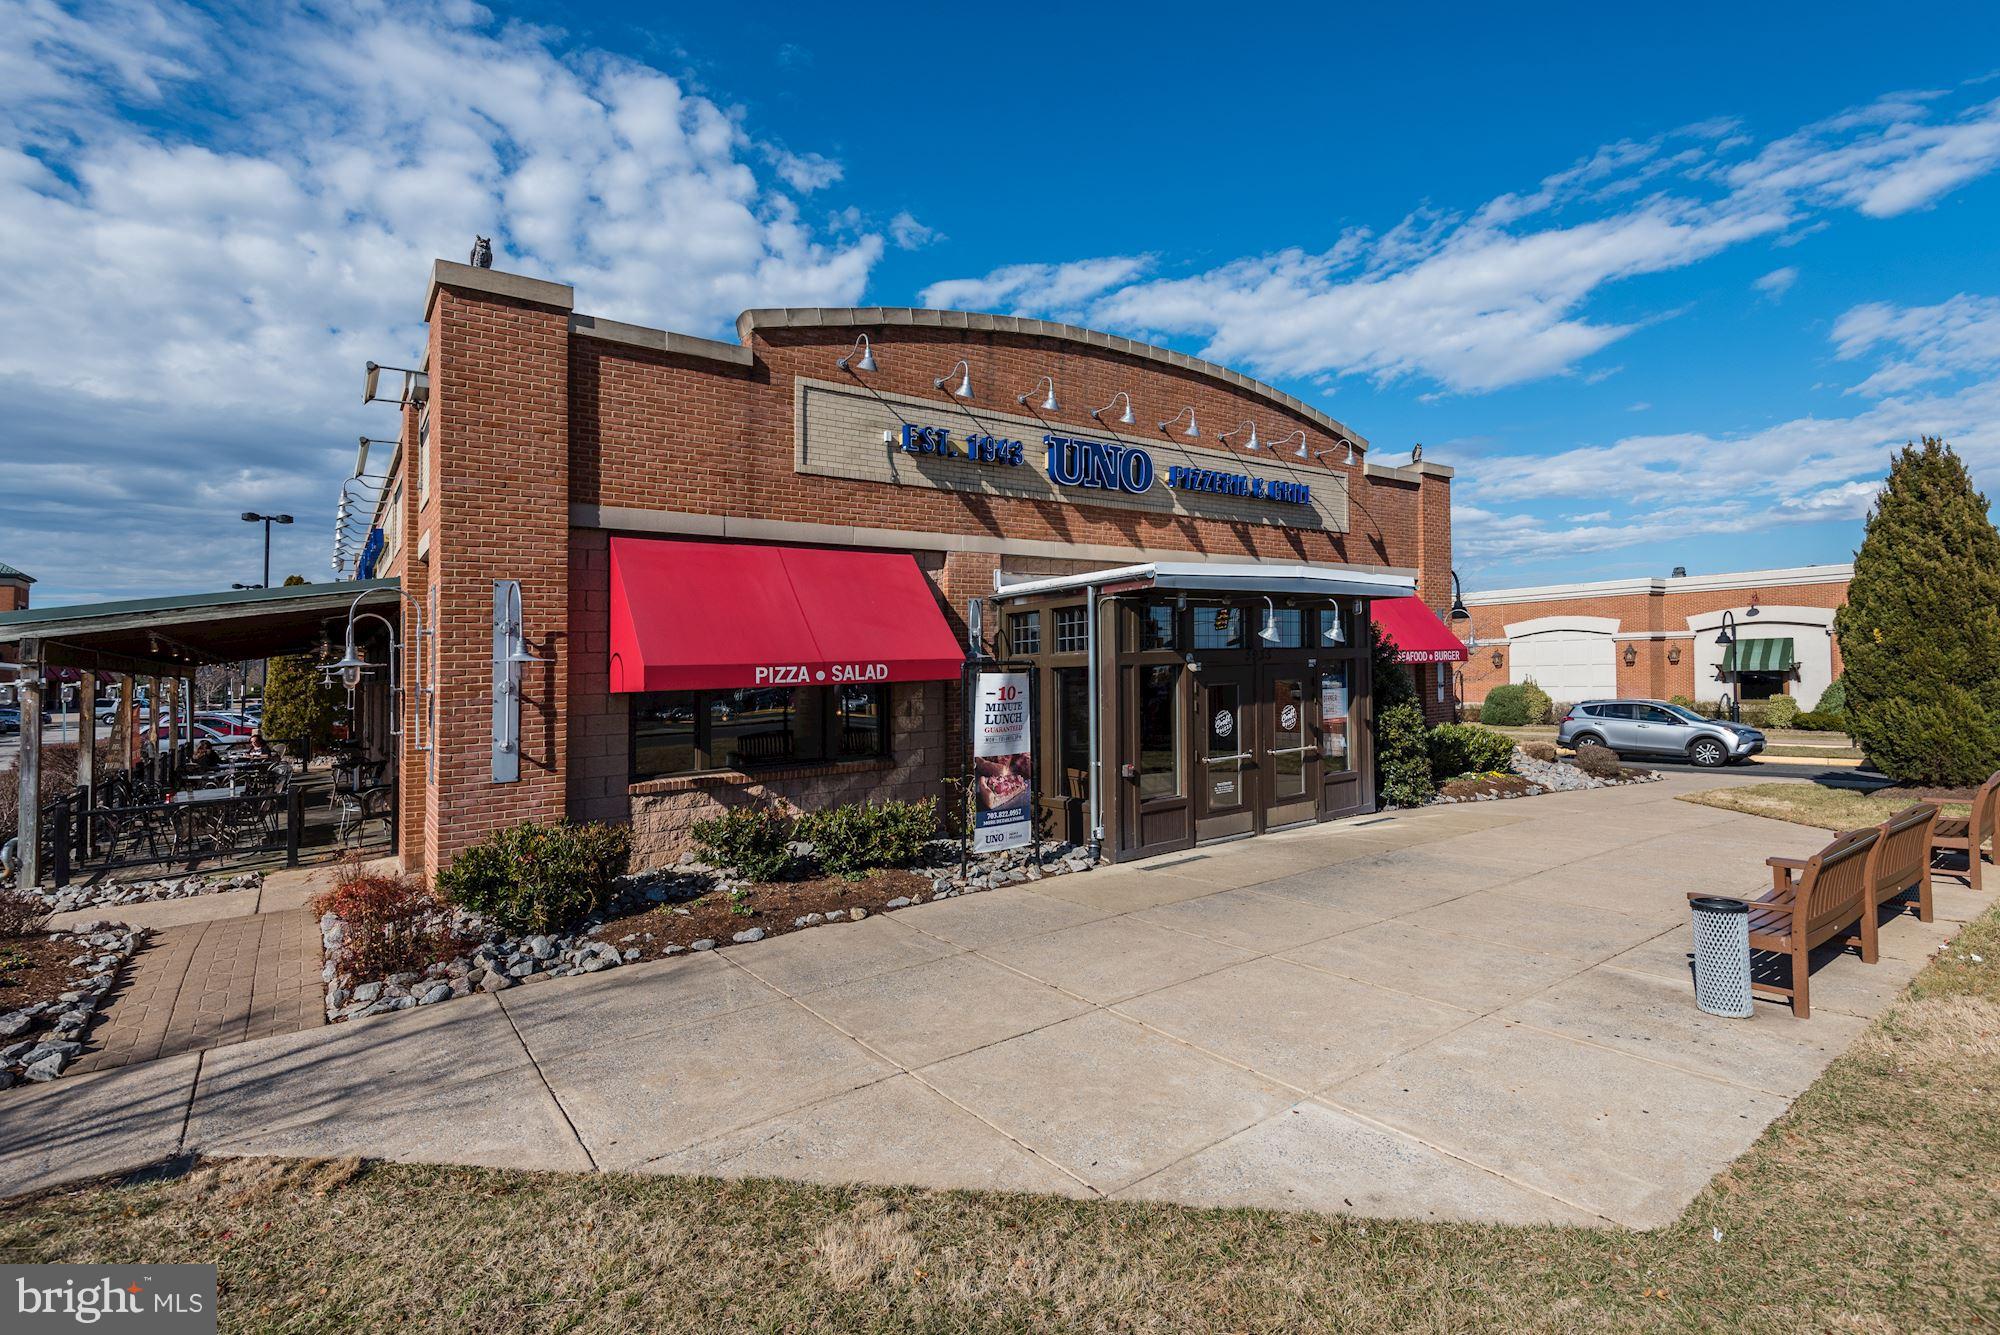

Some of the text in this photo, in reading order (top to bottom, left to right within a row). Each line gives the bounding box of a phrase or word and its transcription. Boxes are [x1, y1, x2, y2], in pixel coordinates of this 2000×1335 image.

[902, 423, 1024, 467] EST. 1943
[1043, 434, 1155, 495] UNO
[1168, 466, 1312, 505] PIZZERIA & GRILL
[1434, 650, 1460, 661] BURGER
[755, 664, 889, 684] PIZZA SALAD
[998, 685, 1016, 701] 10
[984, 701, 1023, 712] MINUTE
[984, 712, 1022, 725] LUNCH
[984, 725, 1023, 734] GUARANTEED
[985, 833, 1004, 844] UNO
